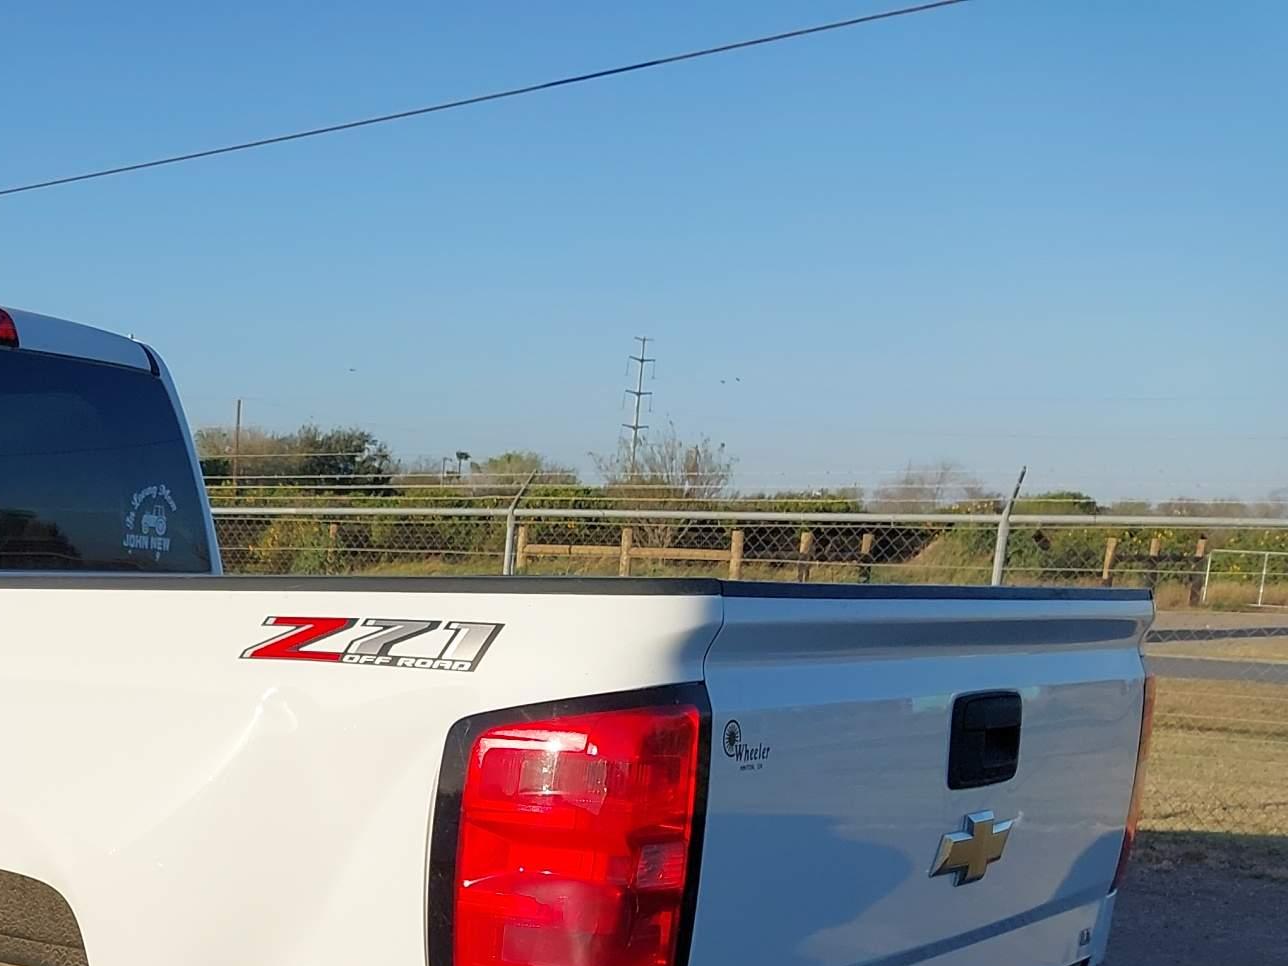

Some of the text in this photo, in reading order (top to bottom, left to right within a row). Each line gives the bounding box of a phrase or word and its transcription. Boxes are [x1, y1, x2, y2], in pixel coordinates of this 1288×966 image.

[238, 616, 505, 670] Z71
[342, 653, 472, 672] OFF ROAD
[735, 742, 771, 761] Wheeler
